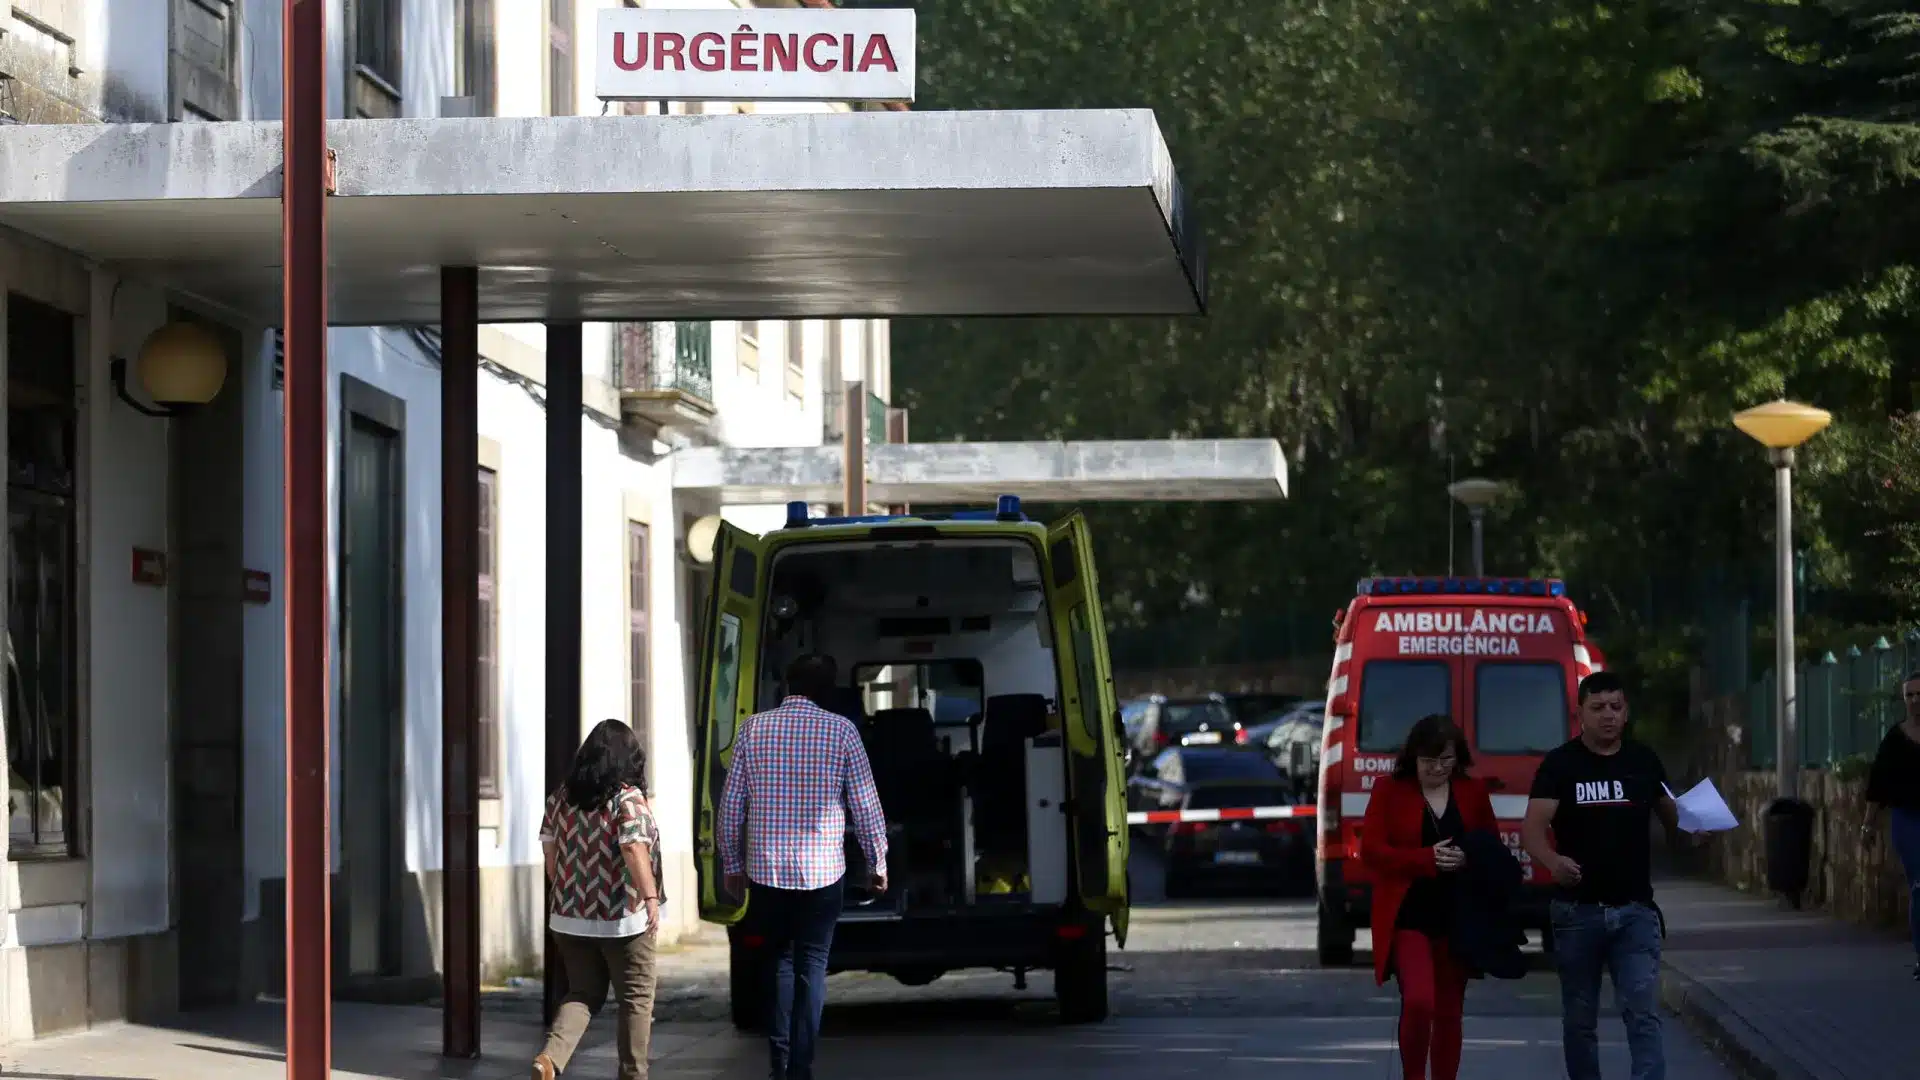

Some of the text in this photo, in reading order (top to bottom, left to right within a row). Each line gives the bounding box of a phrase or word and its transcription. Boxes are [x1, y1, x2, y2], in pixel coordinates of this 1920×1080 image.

[613, 24, 899, 73] URGÊNCIA
[1374, 609, 1555, 634] AMBULÂNCIA
[1398, 633, 1521, 655] EMERGÊNCIA
[1576, 780, 1624, 801] DNM B
